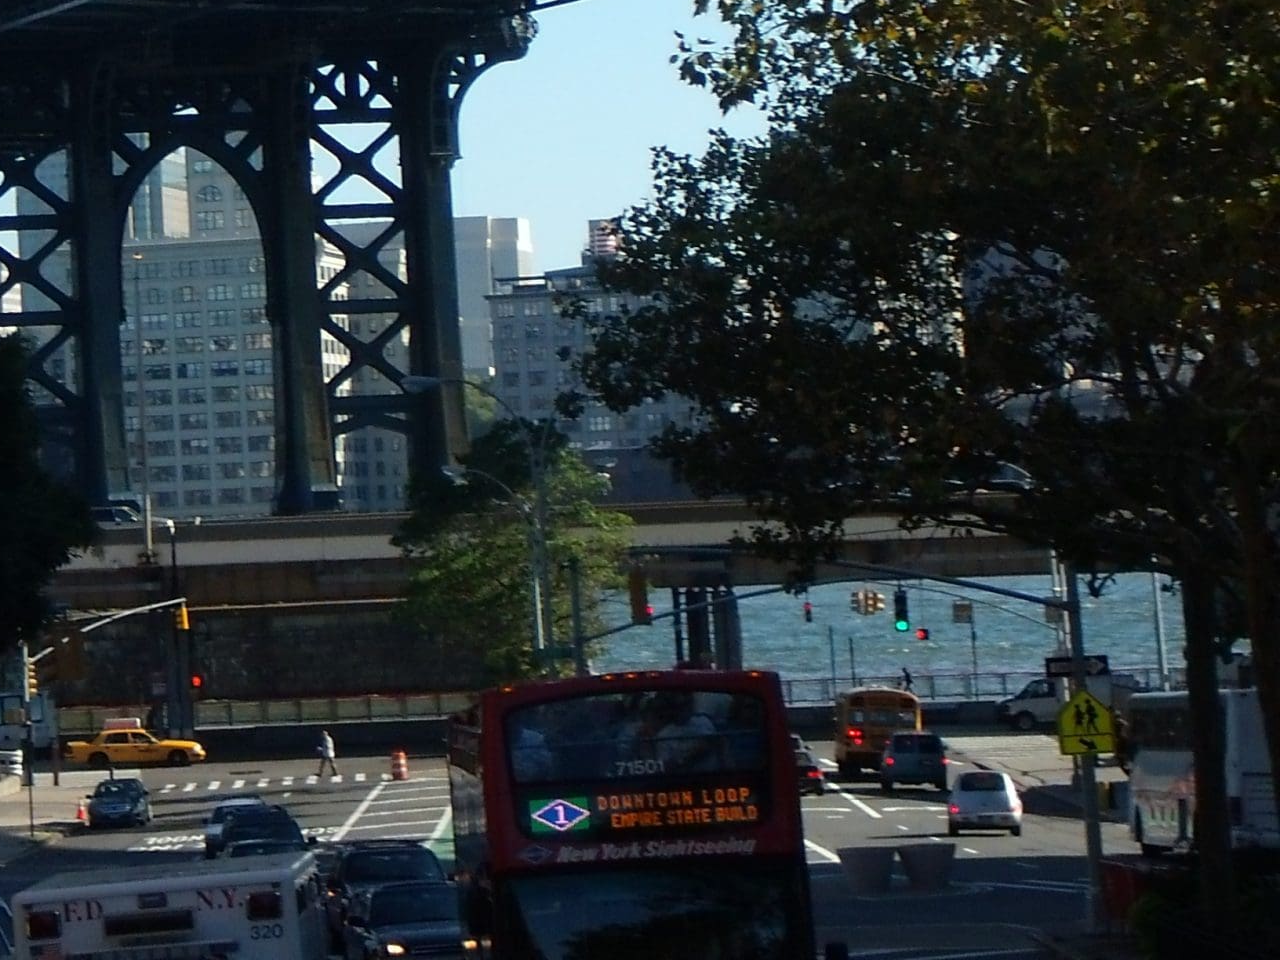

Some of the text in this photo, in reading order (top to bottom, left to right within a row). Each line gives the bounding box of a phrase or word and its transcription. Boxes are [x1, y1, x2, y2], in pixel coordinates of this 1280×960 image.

[614, 759, 665, 776] 71501
[597, 787, 751, 811] DOWNTOWN LOOP
[554, 805, 569, 825] 1
[610, 805, 759, 829] EMPIRE STATE BUILD
[557, 837, 758, 863] New York Sightseeing
[250, 924, 284, 940] 320
